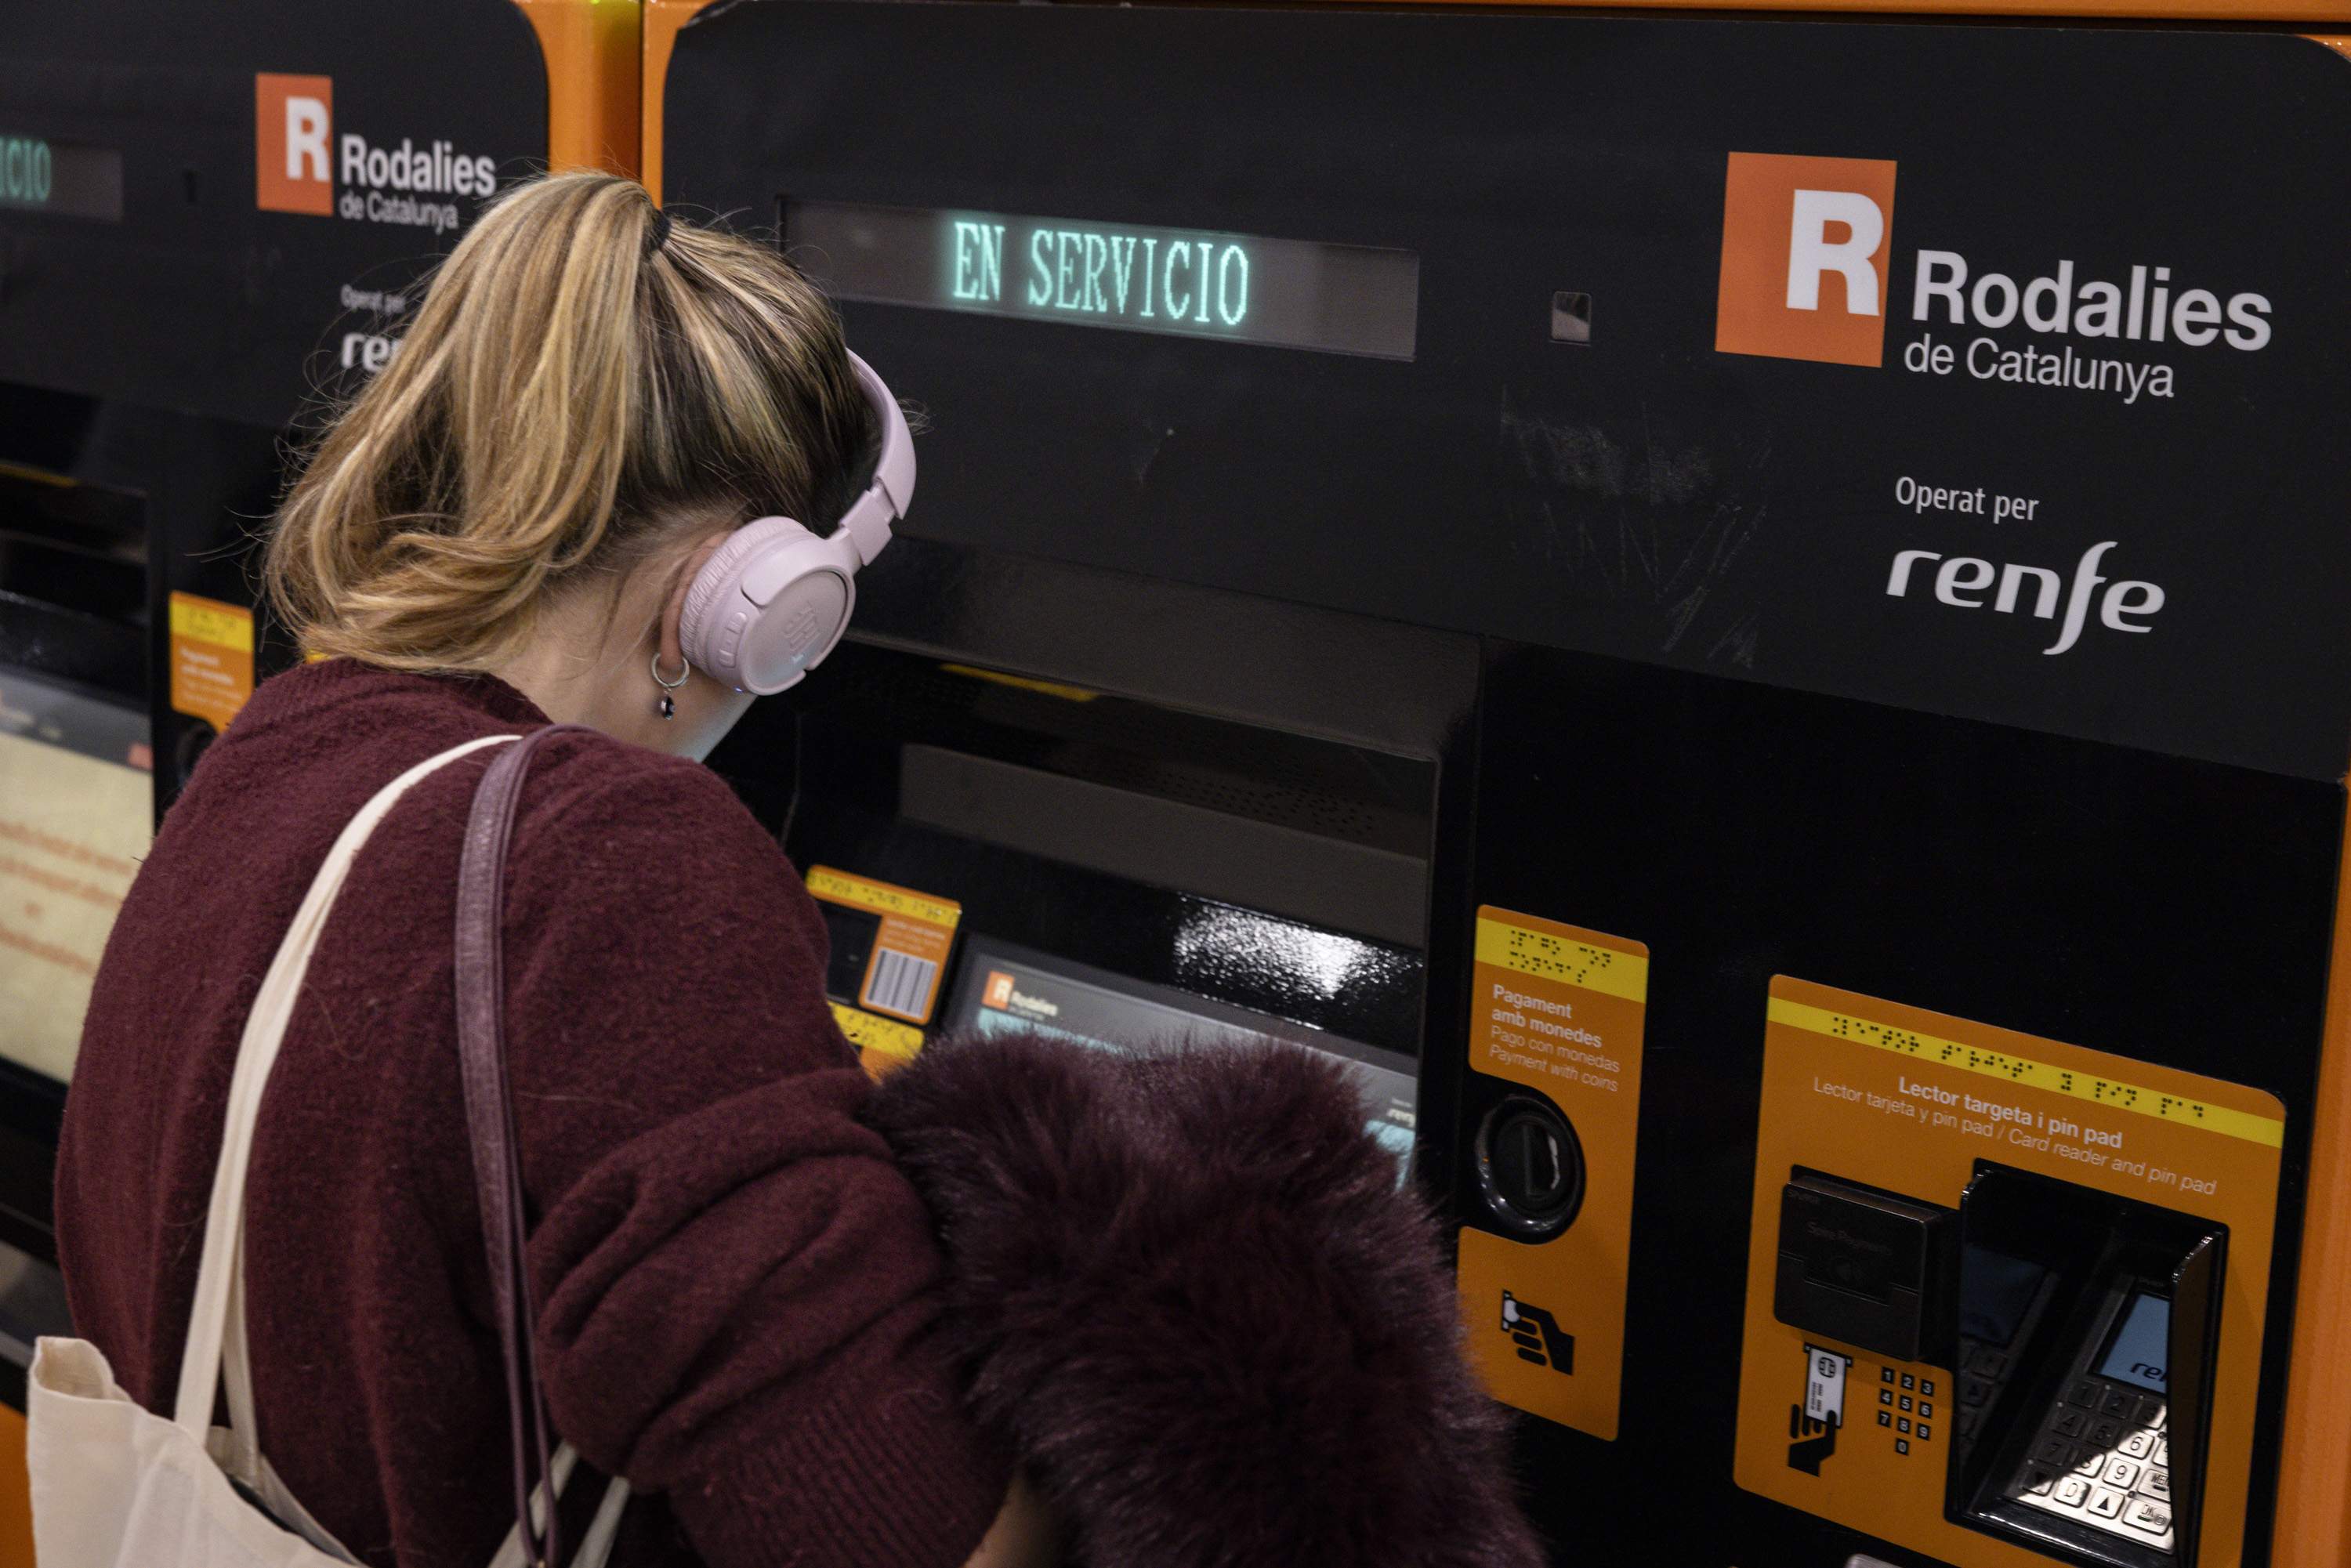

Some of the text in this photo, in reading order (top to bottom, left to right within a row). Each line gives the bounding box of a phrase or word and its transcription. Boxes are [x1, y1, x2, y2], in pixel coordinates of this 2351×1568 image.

[285, 96, 330, 183] R
[341, 133, 497, 196] Rodalies
[339, 190, 459, 235] de Catalunya
[953, 221, 1249, 326] EN SERVICIO
[1786, 188, 1884, 317] R
[1911, 248, 2273, 352] Rodalies
[342, 332, 402, 374] re
[1904, 332, 2175, 404] de Catalunya
[1895, 476, 2040, 524] Operat per
[1886, 541, 2166, 655] renfe
[1493, 983, 1573, 1019] Pagament
[1491, 1008, 1603, 1048] amb monedes
[1491, 1025, 1621, 1073] Pago con monedas
[1491, 1044, 1618, 1092] Payment with coins
[1813, 1077, 1863, 1103] Lector
[1867, 1092, 1915, 1117] tarjeta
[1919, 1108, 1929, 1123] y
[1932, 1110, 1958, 1128] pin
[1962, 1117, 1994, 1137] pad
[2009, 1128, 2050, 1152] Card
[2052, 1142, 2109, 1167] reader
[2111, 1157, 2146, 1177] and
[2147, 1168, 2177, 1185] pin
[2179, 1174, 2217, 1195] pad
[1898, 1076, 2123, 1149] Lector targeta i pin pad
[1884, 1371, 1933, 1394] 1 2 3
[2130, 1363, 2167, 1382] re
[1880, 1414, 1929, 1438] 7 8 9
[1882, 1392, 1930, 1416] 4 5 6
[2130, 1436, 2143, 1451] 6
[2114, 1465, 2127, 1479] 9
